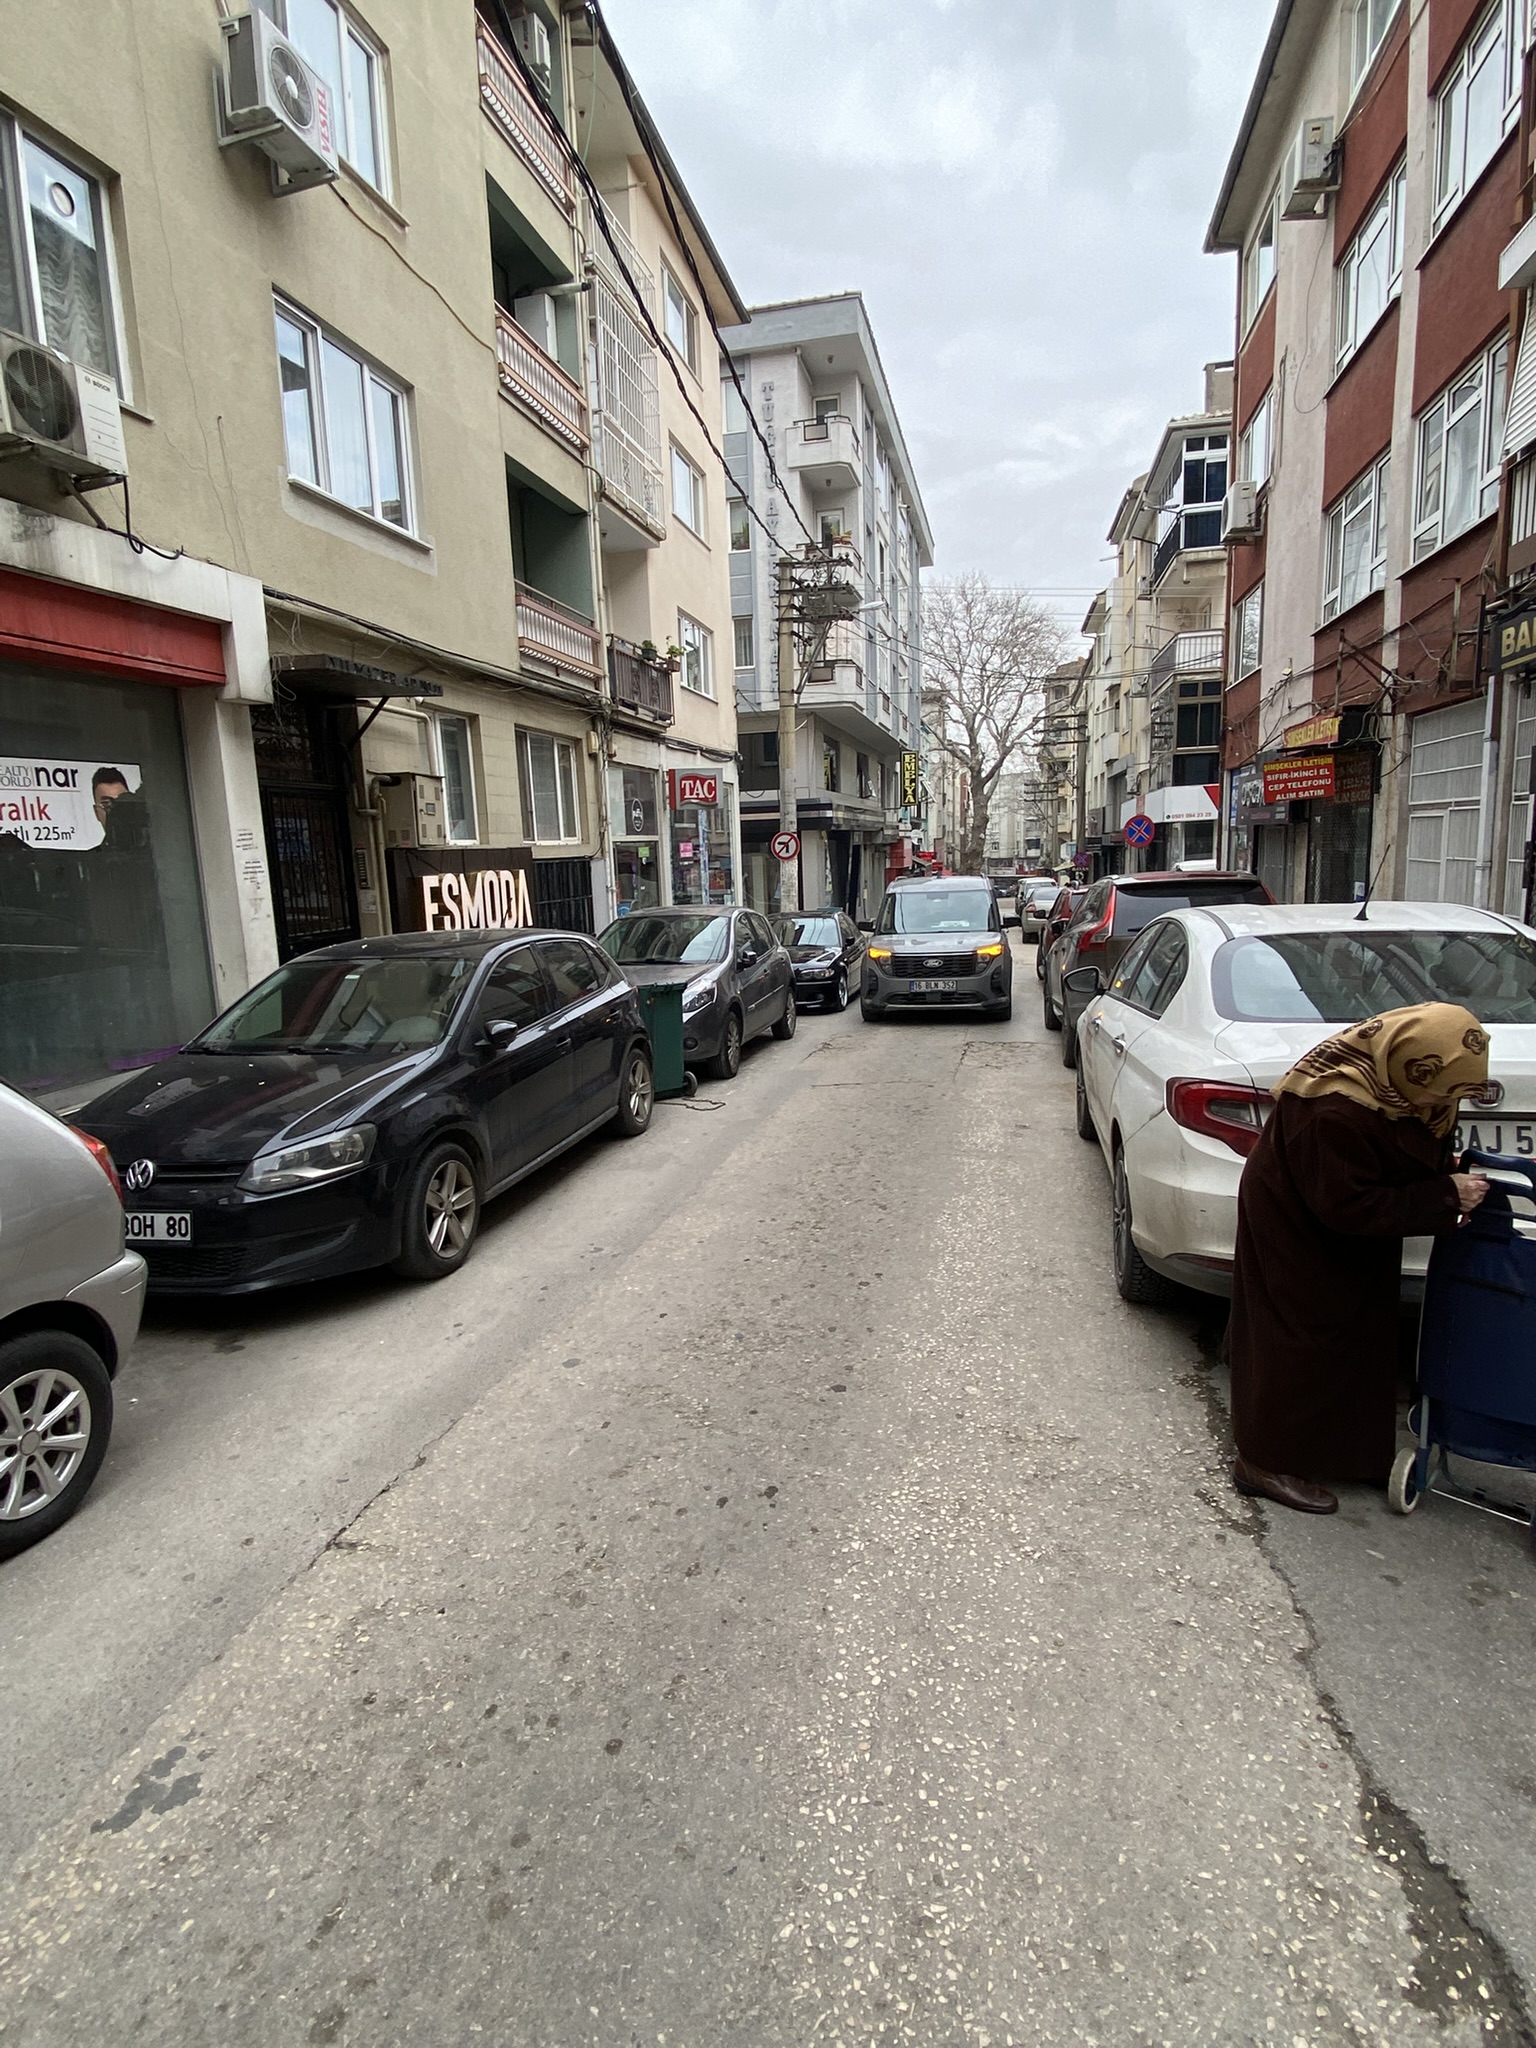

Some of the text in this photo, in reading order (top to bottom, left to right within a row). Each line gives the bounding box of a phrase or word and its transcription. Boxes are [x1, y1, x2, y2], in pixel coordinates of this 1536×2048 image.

[1501, 620, 1536, 658] BA
[0, 775, 32, 788] ORLD
[35, 766, 79, 788] nar
[904, 754, 916, 803] EMELYA
[1266, 768, 1317, 781] SIFIR-İKİNCİ
[1268, 778, 1332, 791] CEP TELEFONU
[1275, 789, 1325, 801] ALIM SATIM
[422, 868, 533, 933] ESMODA
[166, 1215, 189, 1238] 80
